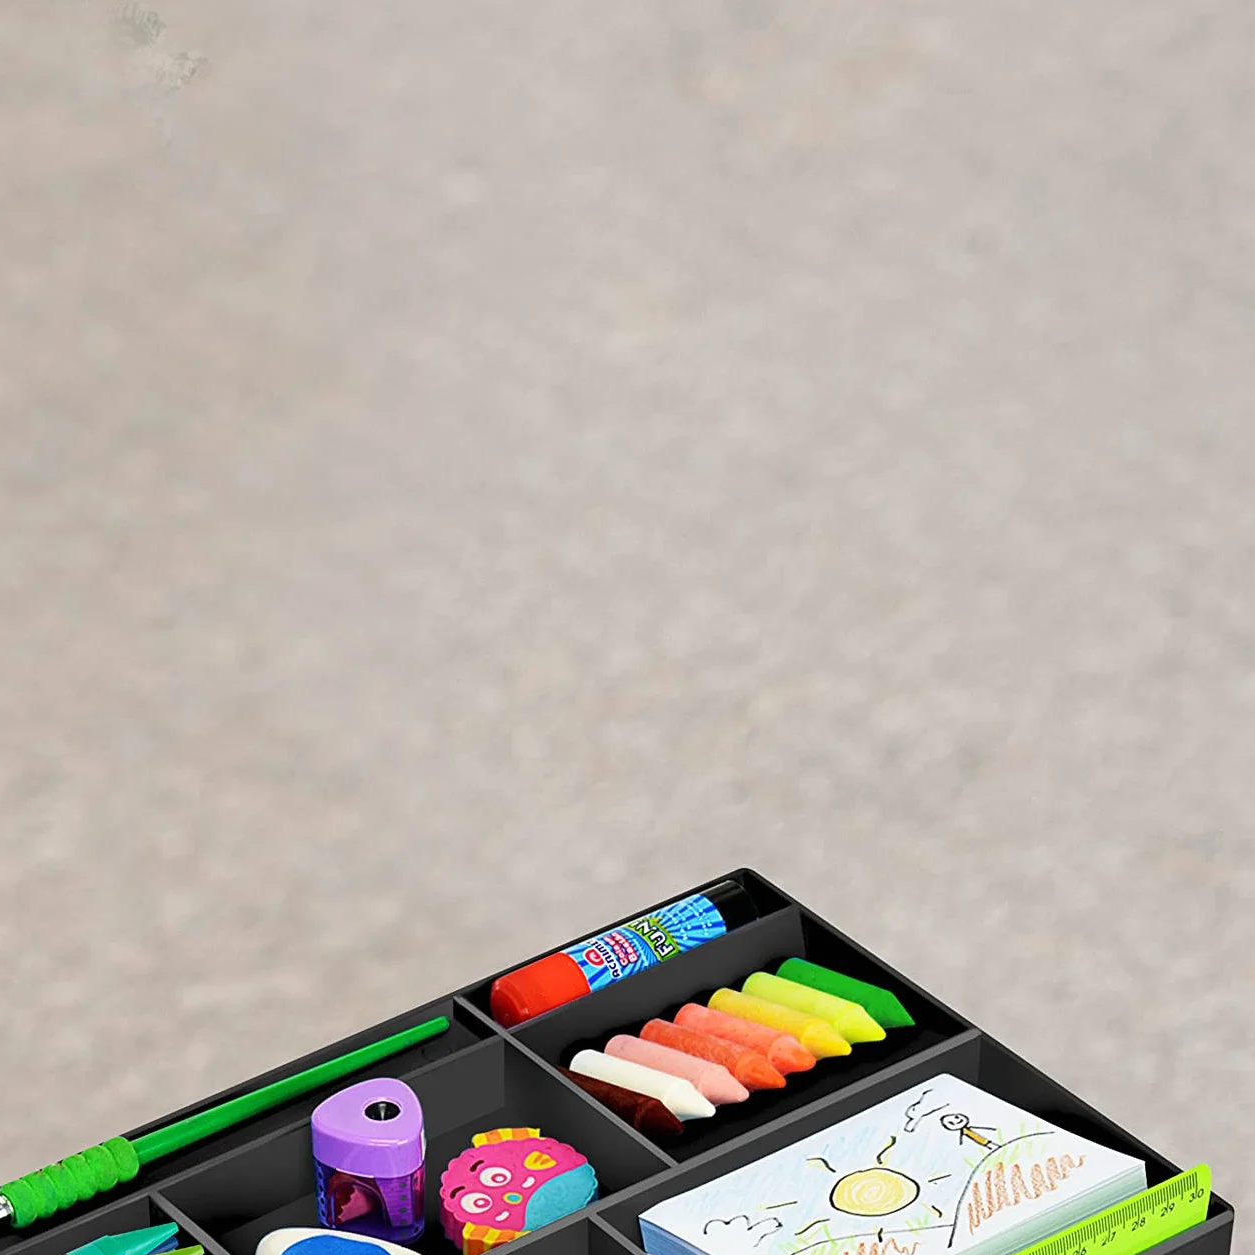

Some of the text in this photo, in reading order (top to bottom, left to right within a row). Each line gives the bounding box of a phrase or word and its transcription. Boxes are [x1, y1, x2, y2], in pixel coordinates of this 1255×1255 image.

[1101, 1231, 1117, 1247] 27
[1131, 1217, 1146, 1231] 28
[1160, 1203, 1175, 1217] 29
[1189, 1188, 1205, 1203] 30
